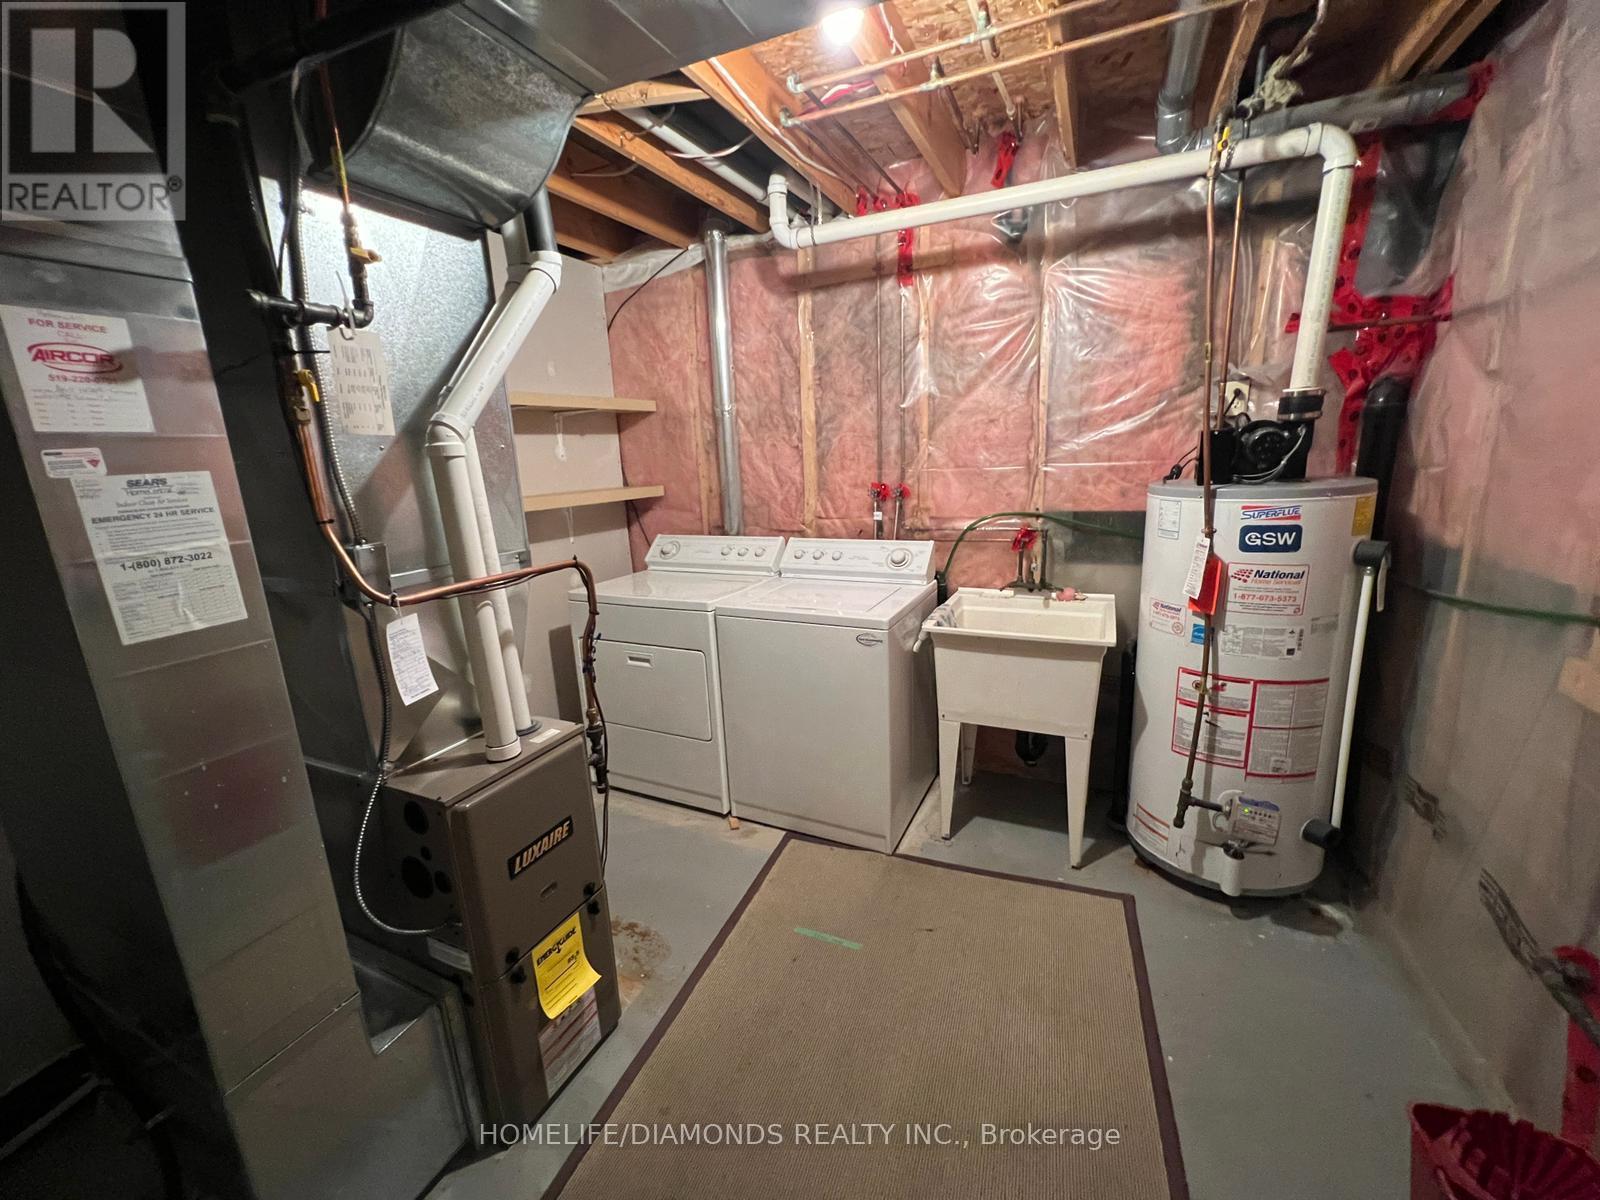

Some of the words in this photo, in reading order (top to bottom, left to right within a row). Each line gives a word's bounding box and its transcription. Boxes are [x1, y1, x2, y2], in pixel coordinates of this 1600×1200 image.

[27, 318, 54, 328] FOR
[57, 321, 107, 334] SERVICE
[31, 347, 115, 364] AIRCOR
[126, 478, 168, 488] SEARS
[91, 514, 150, 525] EMERGENCY
[153, 511, 163, 519] 24
[165, 510, 178, 518] HR
[180, 507, 215, 517] SERVICE
[1241, 506, 1302, 520] SUPERFLUE
[1245, 531, 1296, 546] GSW
[120, 557, 162, 571] 1-(800)
[164, 551, 213, 566] 872-3022
[1254, 569, 1306, 580] National
[514, 820, 572, 875] LUXAIRE
